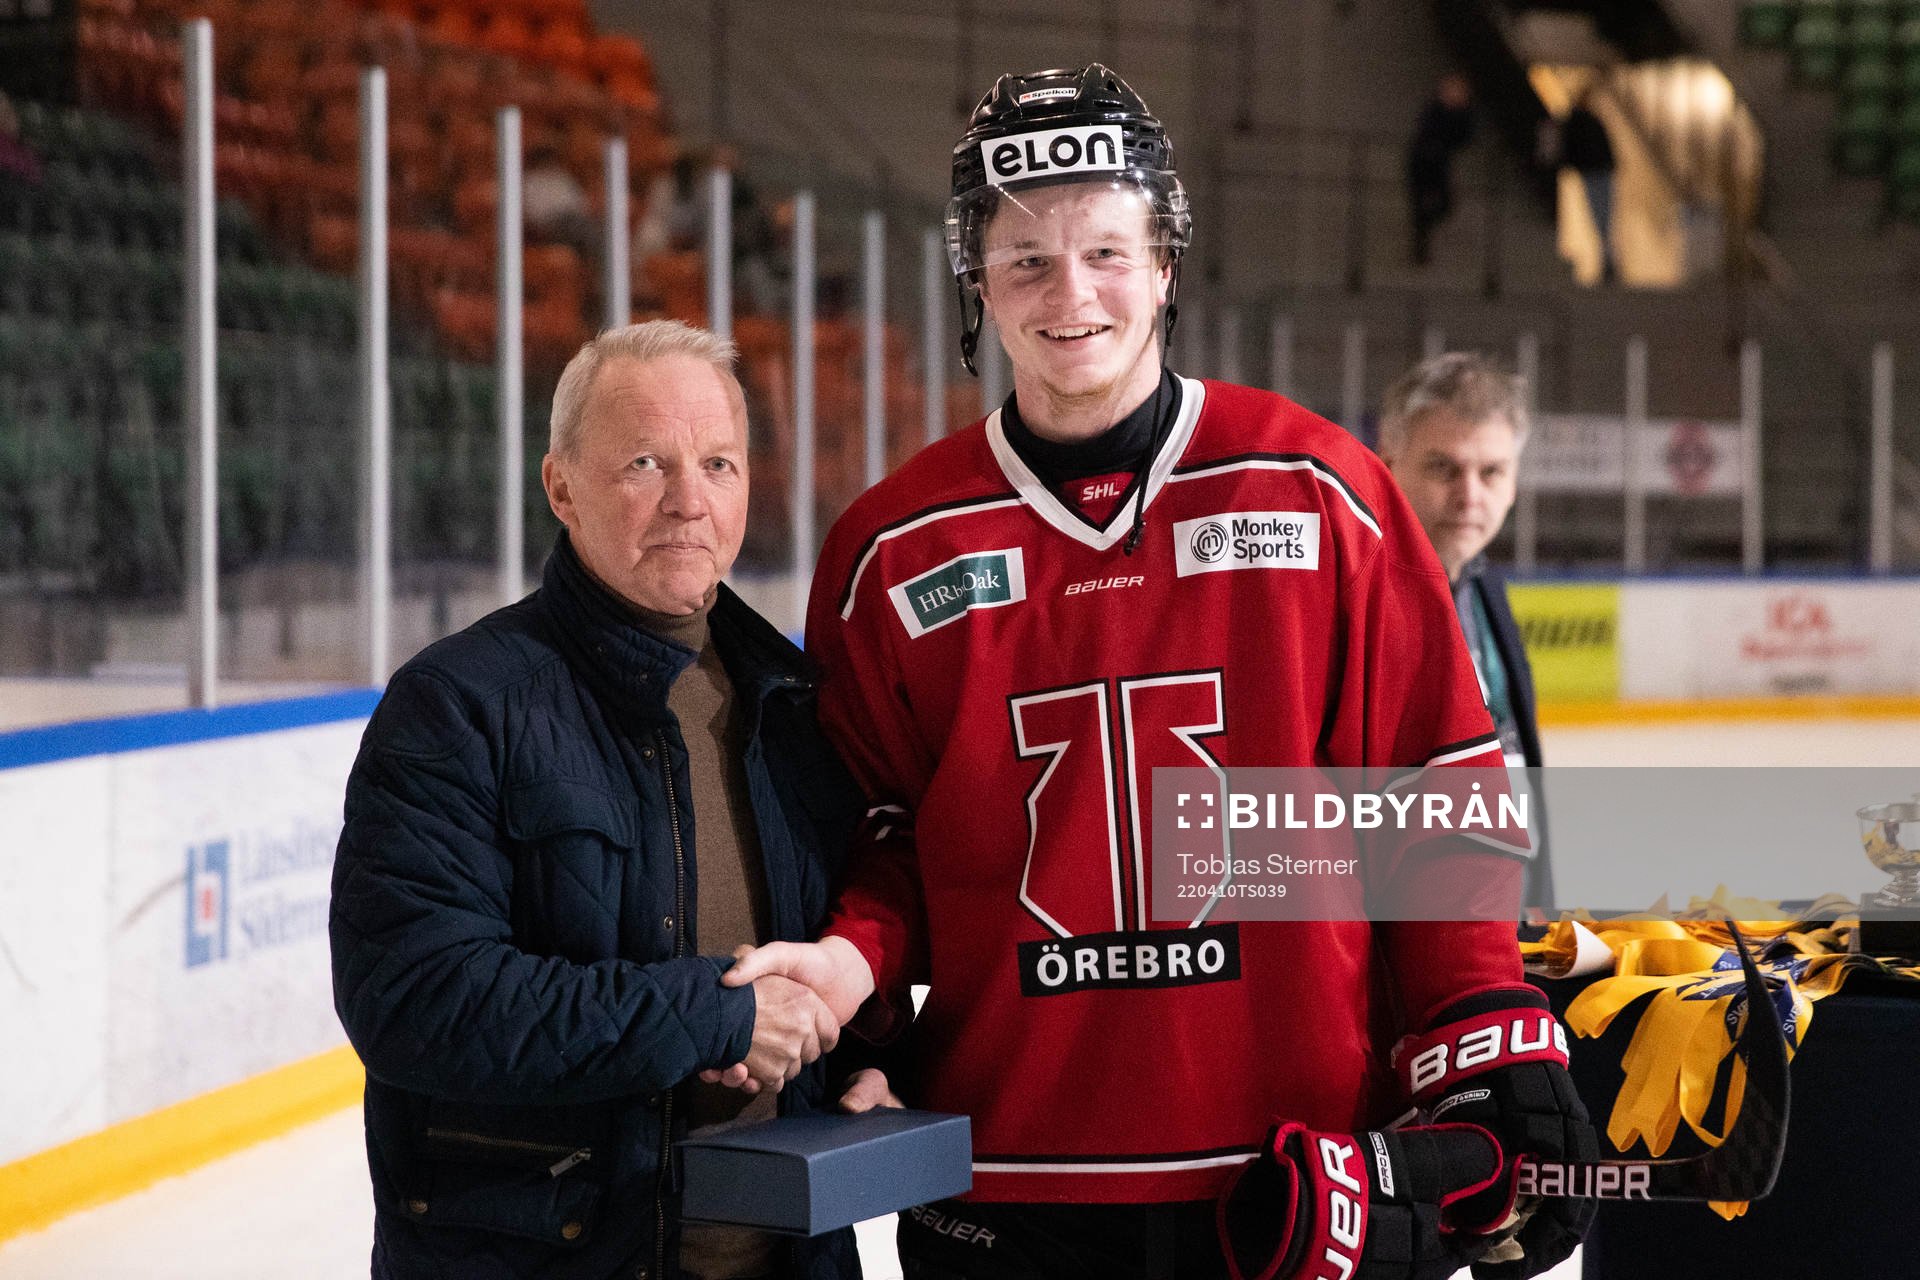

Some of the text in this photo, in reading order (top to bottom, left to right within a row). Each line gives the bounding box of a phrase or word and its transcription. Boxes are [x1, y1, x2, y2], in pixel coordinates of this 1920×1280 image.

[1082, 482, 1120, 501] SHL
[1232, 518, 1304, 541] Monkey
[1233, 538, 1305, 563] Sports
[917, 585, 957, 613] HR
[962, 569, 1002, 591] Oak
[1065, 575, 1144, 596] BAUER
[1036, 939, 1225, 987] ÖREBRO
